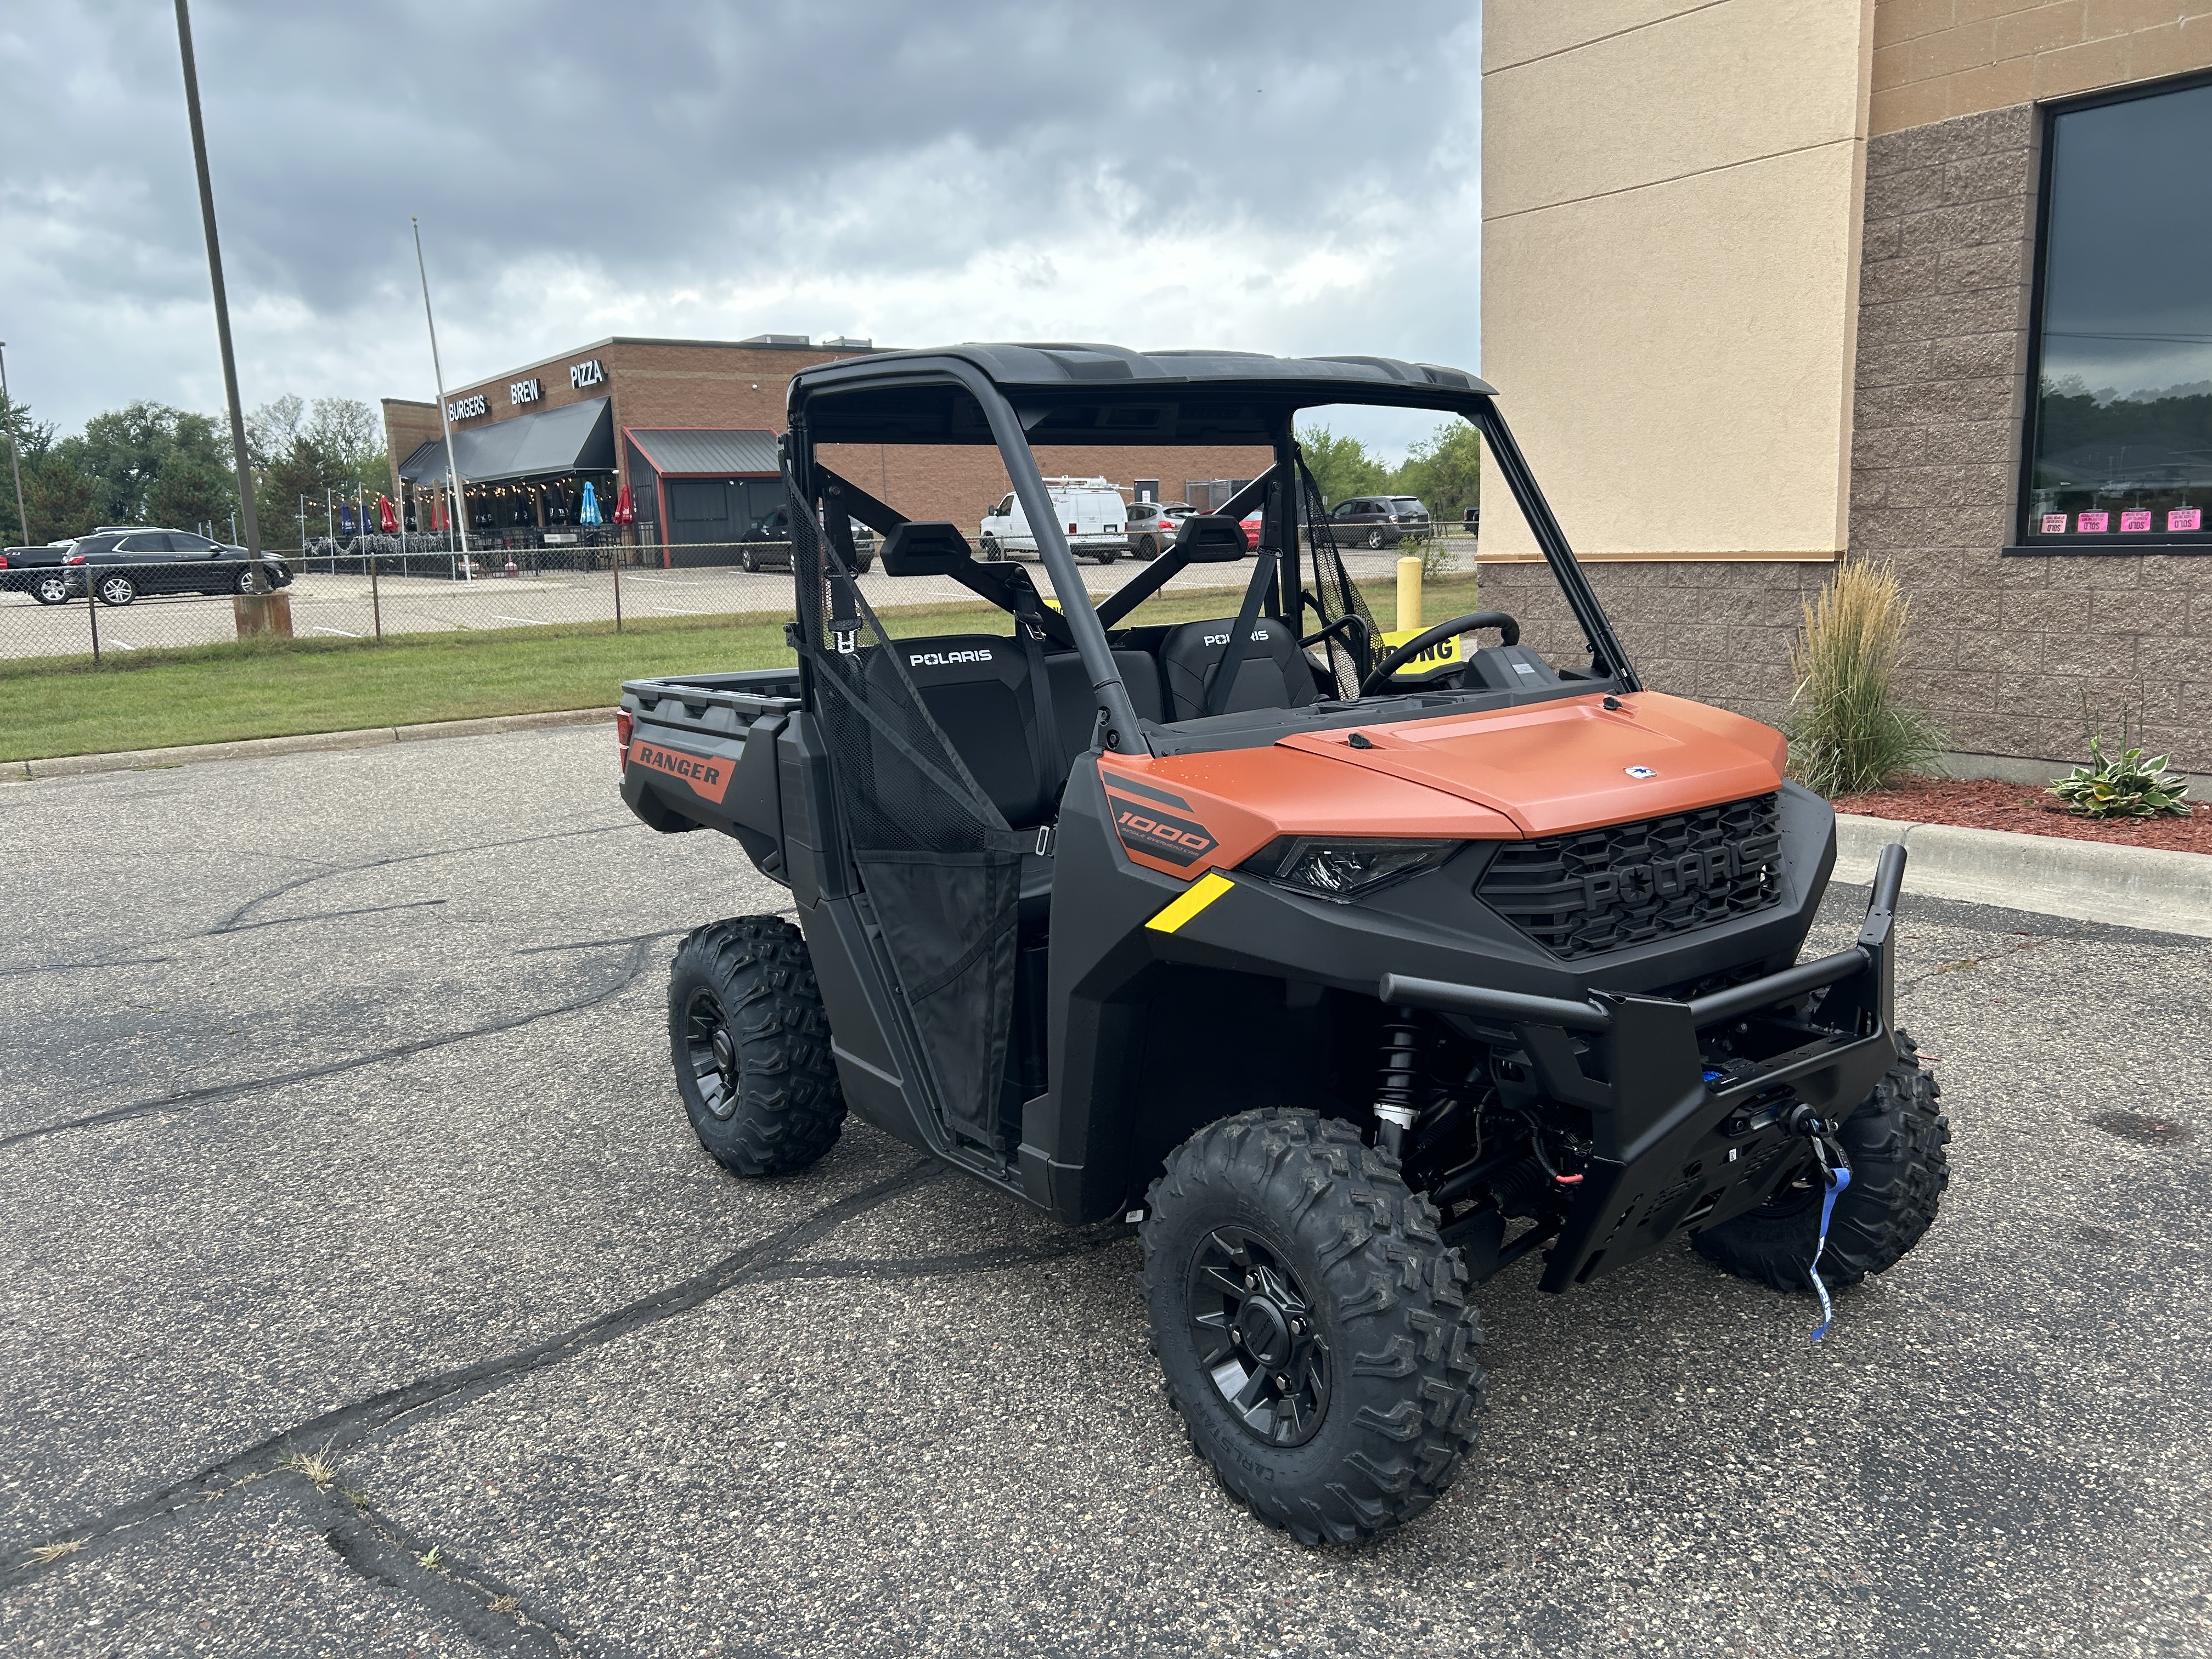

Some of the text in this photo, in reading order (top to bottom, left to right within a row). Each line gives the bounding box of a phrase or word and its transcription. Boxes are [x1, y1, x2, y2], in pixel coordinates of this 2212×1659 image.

[449, 360, 603, 422] BURGERS BREW PIZZA
[2047, 524, 2061, 532] SOLD
[2128, 521, 2145, 529] SOLD
[2175, 519, 2192, 528] SOLD
[909, 649, 992, 667] POLARIS
[640, 747, 720, 785] RANGER
[1118, 811, 1210, 850] 1000
[1121, 827, 1200, 857] SINGLE OVERHEAD CAM
[1583, 836, 1764, 911] POLARIS
